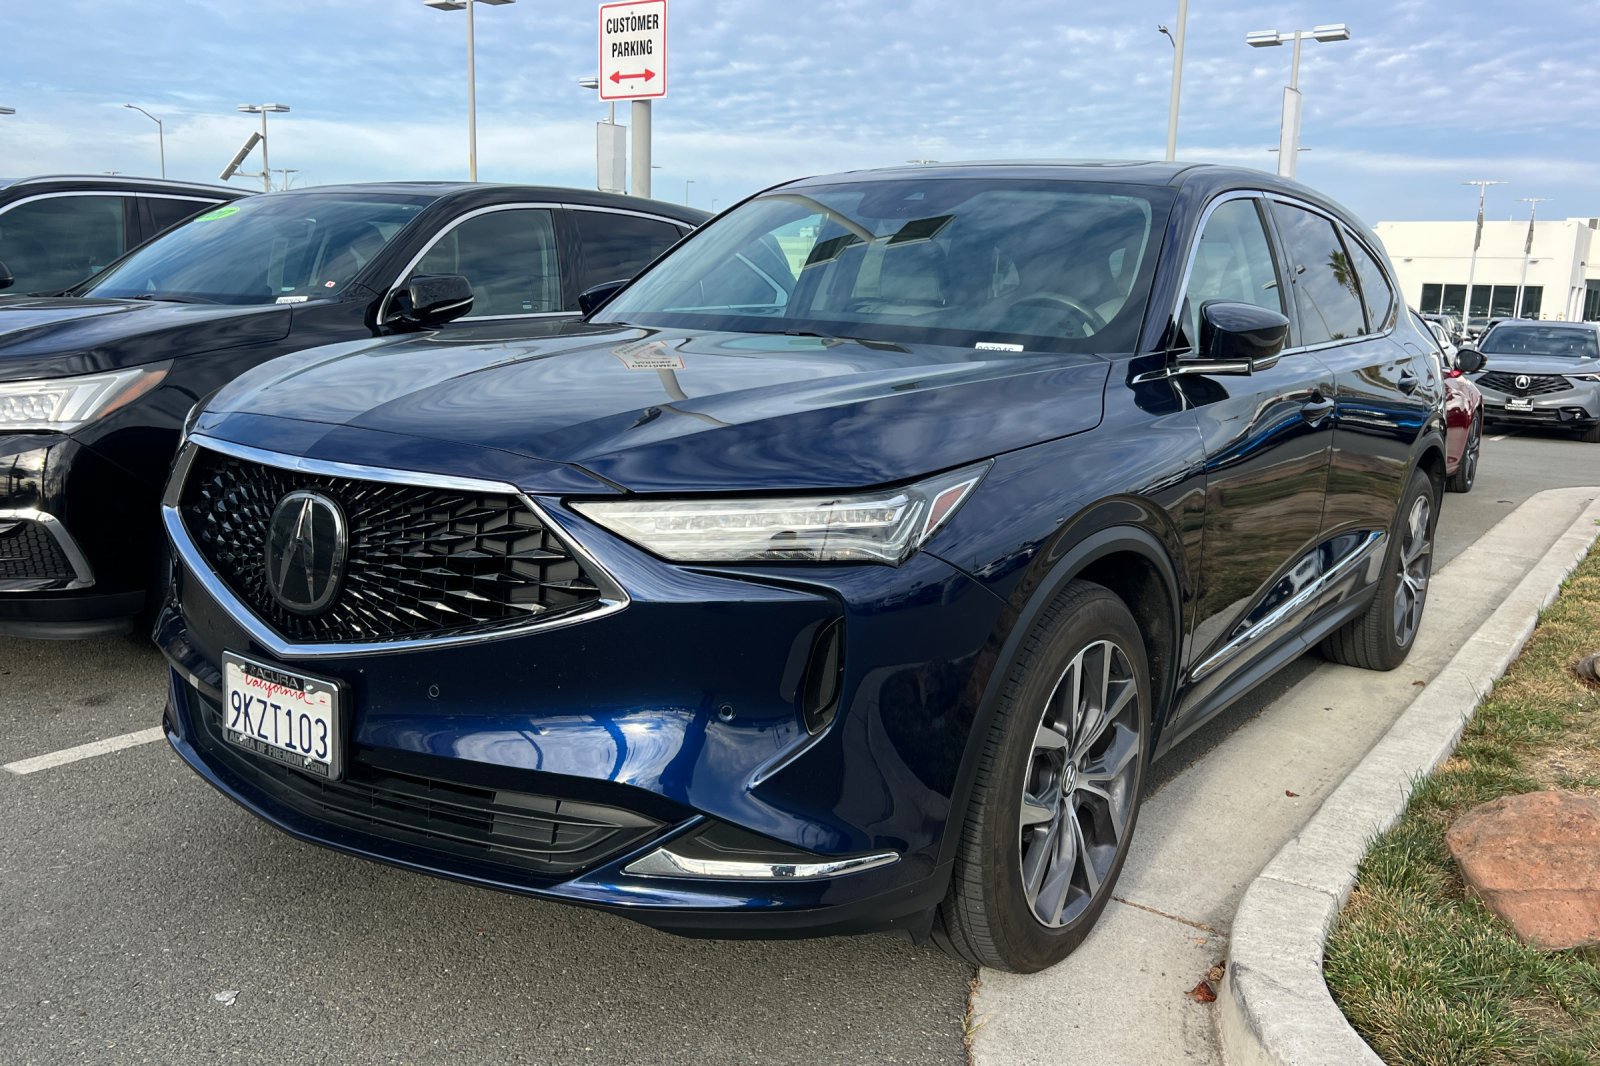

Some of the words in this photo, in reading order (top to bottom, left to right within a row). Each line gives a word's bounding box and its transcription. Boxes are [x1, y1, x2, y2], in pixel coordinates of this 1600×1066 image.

[606, 13, 659, 34] CUSTOMER
[611, 39, 653, 58] PARKING
[256, 667, 299, 689] ACURA
[231, 690, 328, 759] 9KZT103
[257, 742, 267, 755] OF
